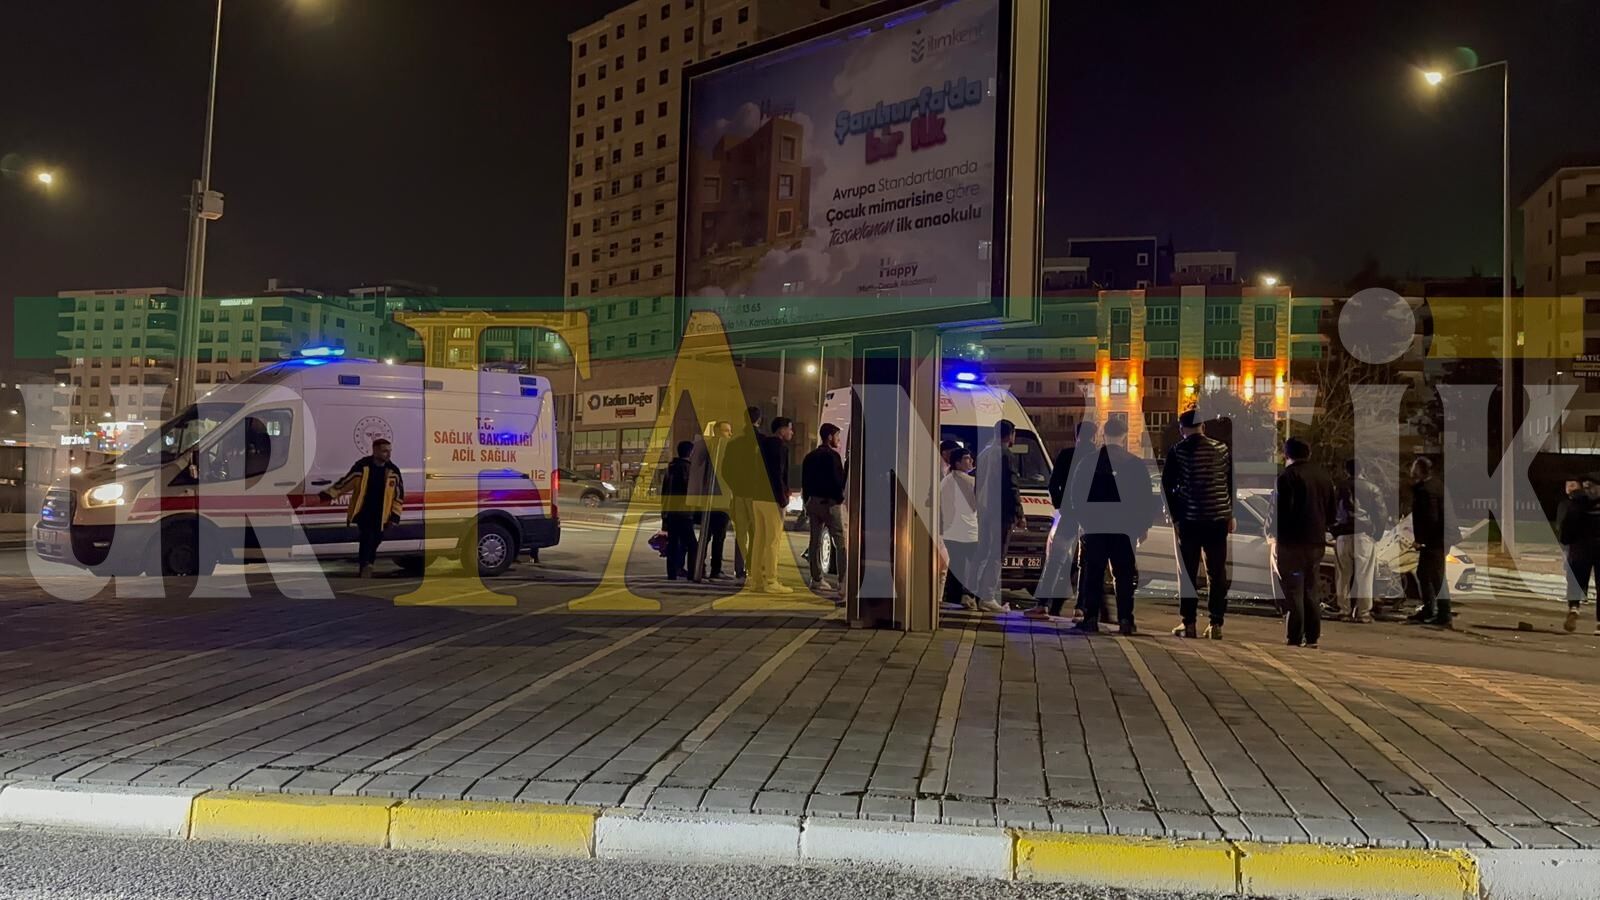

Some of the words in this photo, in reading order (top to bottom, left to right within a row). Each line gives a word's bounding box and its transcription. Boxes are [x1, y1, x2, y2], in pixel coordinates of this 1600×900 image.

[832, 182, 876, 200] Avrupa
[826, 204, 866, 226] Çocuk
[868, 189, 943, 215] mimarisine
[946, 183, 980, 204] göre
[896, 218, 912, 233] ilk
[915, 205, 982, 229] anaokulu
[629, 392, 653, 407] Değer
[434, 429, 473, 445] SAĞLIK
[479, 431, 533, 447] BAKANLIĞI
[452, 447, 476, 462] ACİL
[480, 447, 517, 463] SAĞLIK
[531, 470, 546, 480] 112
[1027, 558, 1040, 566] 262
